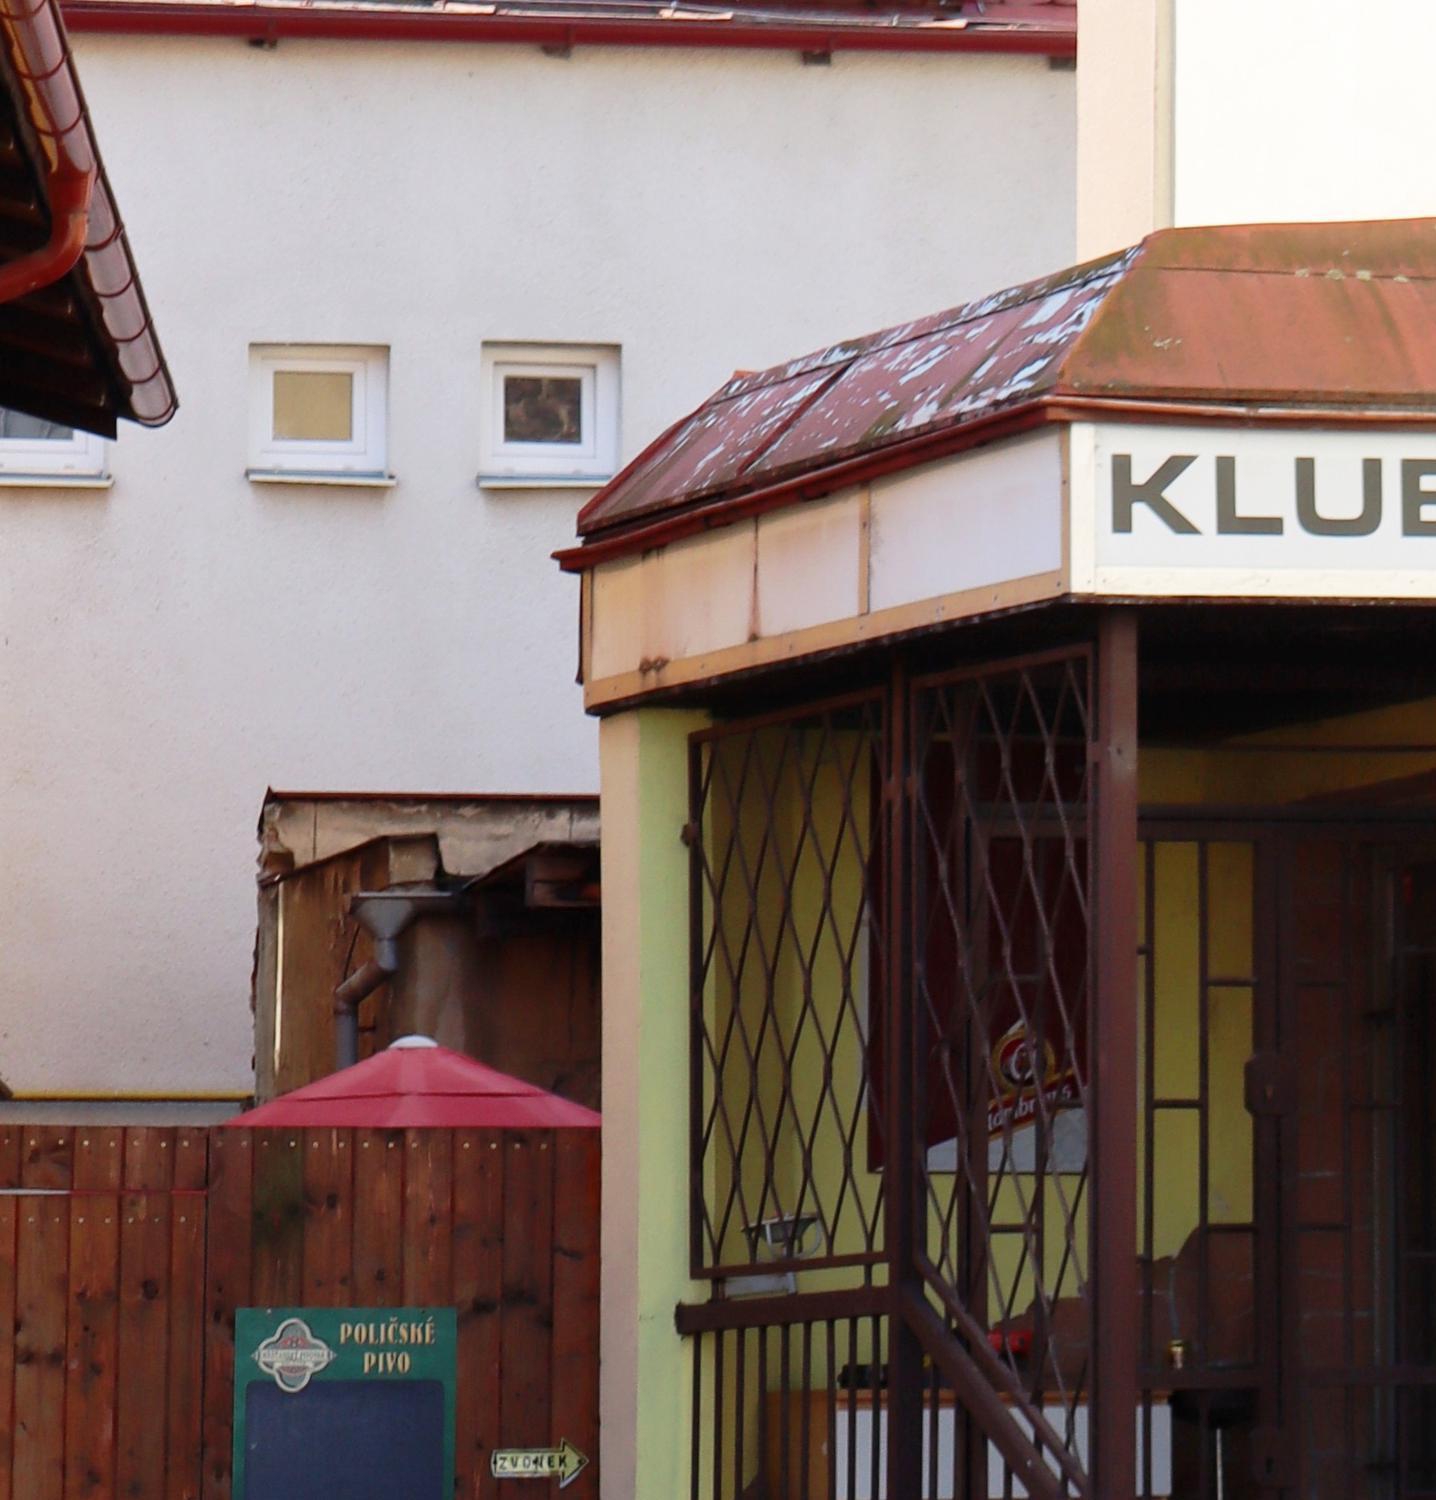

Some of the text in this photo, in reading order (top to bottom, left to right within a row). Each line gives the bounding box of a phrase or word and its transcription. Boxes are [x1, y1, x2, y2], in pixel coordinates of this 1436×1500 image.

[339, 1316, 436, 1344] POLIČSKÉ
[363, 1351, 411, 1374] PIVO
[499, 1454, 567, 1470] ZVONEK
